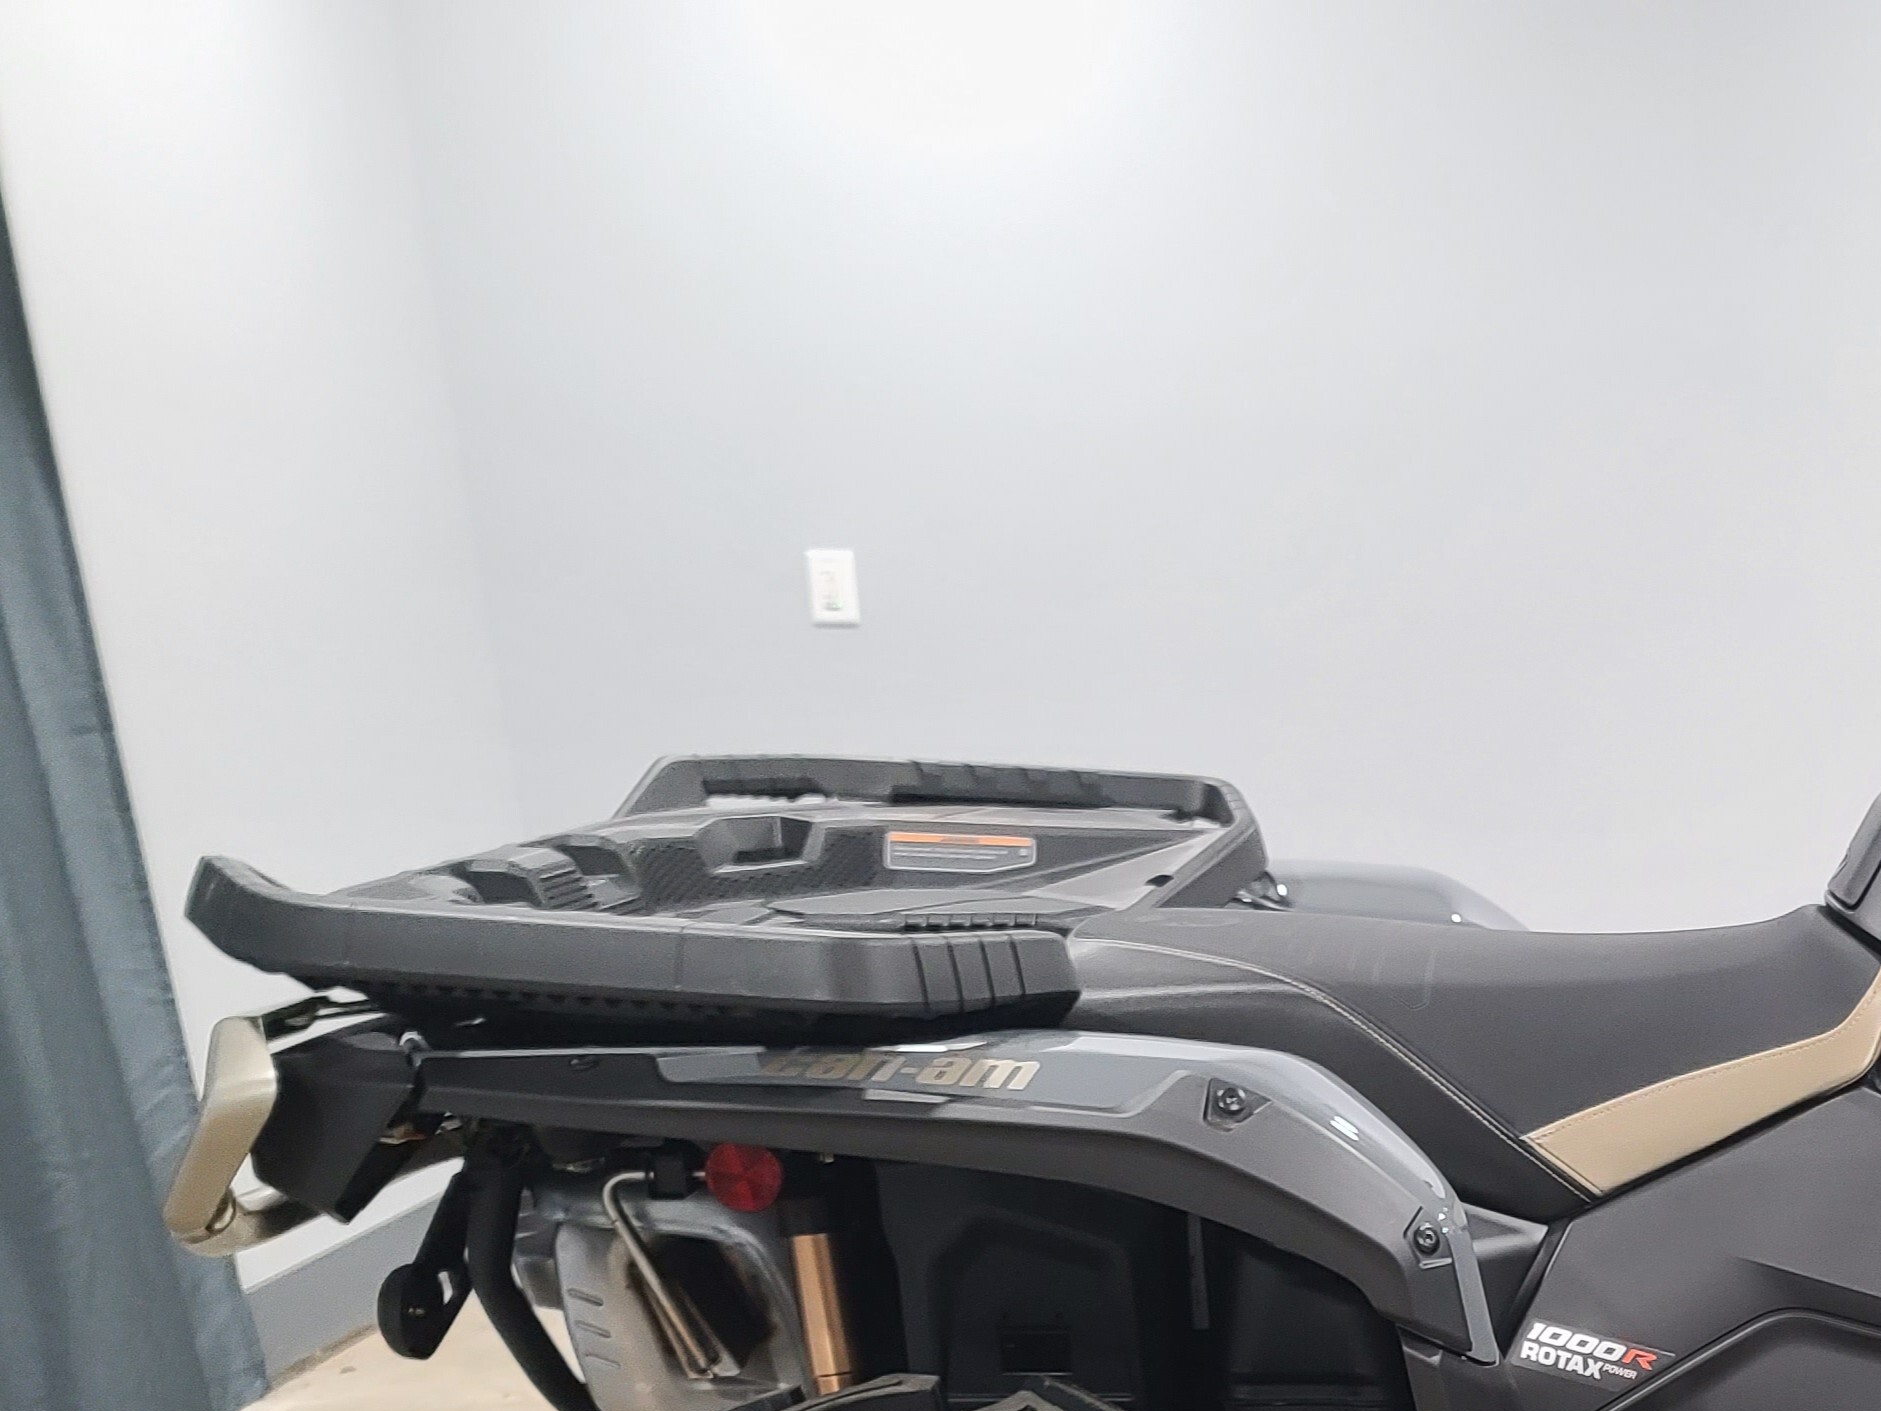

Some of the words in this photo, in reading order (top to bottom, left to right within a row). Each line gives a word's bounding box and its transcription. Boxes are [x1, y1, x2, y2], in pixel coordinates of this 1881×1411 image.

[1519, 1340, 1602, 1380] ROTAX
[1602, 1363, 1638, 1380] POWER
[1526, 1321, 1658, 1371] 1000R
